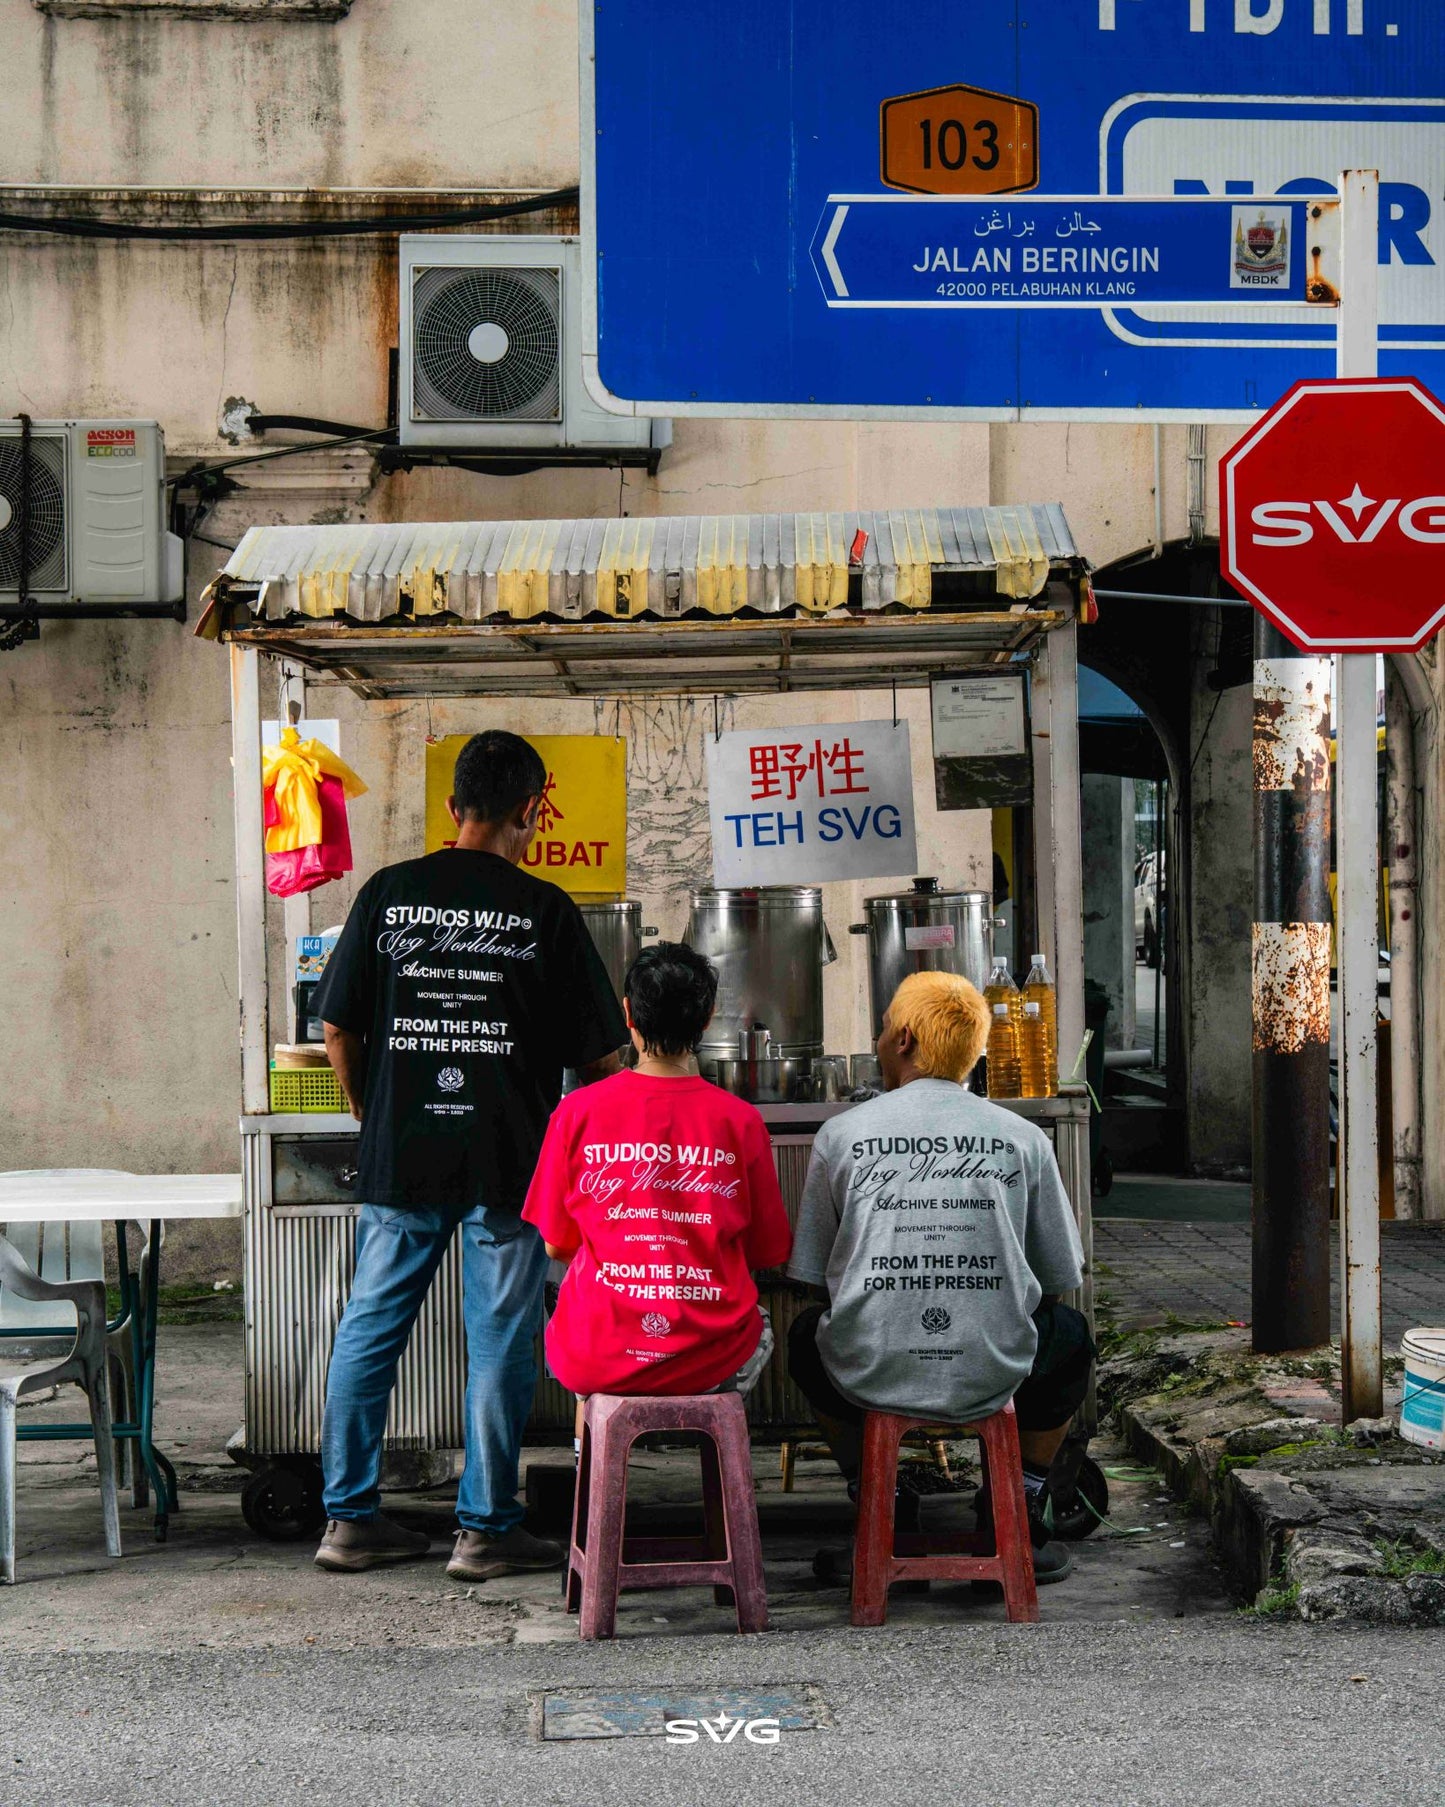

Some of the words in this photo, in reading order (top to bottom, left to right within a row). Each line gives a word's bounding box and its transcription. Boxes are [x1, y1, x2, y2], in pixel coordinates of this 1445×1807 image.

[920, 119, 999, 170] 103
[912, 247, 1010, 273] JALAN
[1022, 247, 1159, 273] BERINGIN
[936, 283, 986, 296] 42000
[991, 283, 1081, 296] PELABUHAN
[1085, 282, 1136, 296] KLANG
[1241, 275, 1279, 285] MBDK
[1251, 482, 1445, 547] SVG
[750, 738, 870, 801] 野性
[724, 810, 804, 848] TEH
[818, 804, 901, 842] SVG
[385, 906, 470, 927] STUDIOS
[429, 921, 537, 961] Worldwide
[457, 969, 504, 983] SUMMER
[417, 991, 455, 1000] MOVEMENT
[456, 993, 487, 1002] THROUGH
[442, 1001, 463, 1009] UNITY
[393, 1017, 438, 1033] FROM
[441, 1020, 469, 1034] THE
[472, 1021, 508, 1036] PAST
[388, 1036, 418, 1051] FOR
[420, 1037, 449, 1052] THE
[452, 1039, 514, 1055] PRESENT
[584, 1142, 672, 1164] STUDIOS
[852, 1136, 948, 1160] STUDIOS
[909, 1148, 1021, 1189] Worldwide
[631, 1159, 741, 1199] Worldwide
[941, 1198, 996, 1211] SUMMER
[661, 1209, 712, 1225] SUMMER
[894, 1225, 937, 1233] MOVEMENT
[624, 1234, 657, 1242] MOVEMENT
[659, 1234, 688, 1246] THROUGH
[602, 1261, 646, 1279] FROM
[648, 1264, 673, 1279] THE
[676, 1264, 713, 1282] PAST
[871, 1255, 918, 1271] FROM
[921, 1254, 954, 1269] THE
[957, 1255, 997, 1270] PAST
[627, 1284, 657, 1299] THE
[658, 1285, 722, 1301] PRESENT
[863, 1276, 896, 1291] FOR
[899, 1276, 931, 1290] THE
[934, 1275, 1003, 1290] PRESENT
